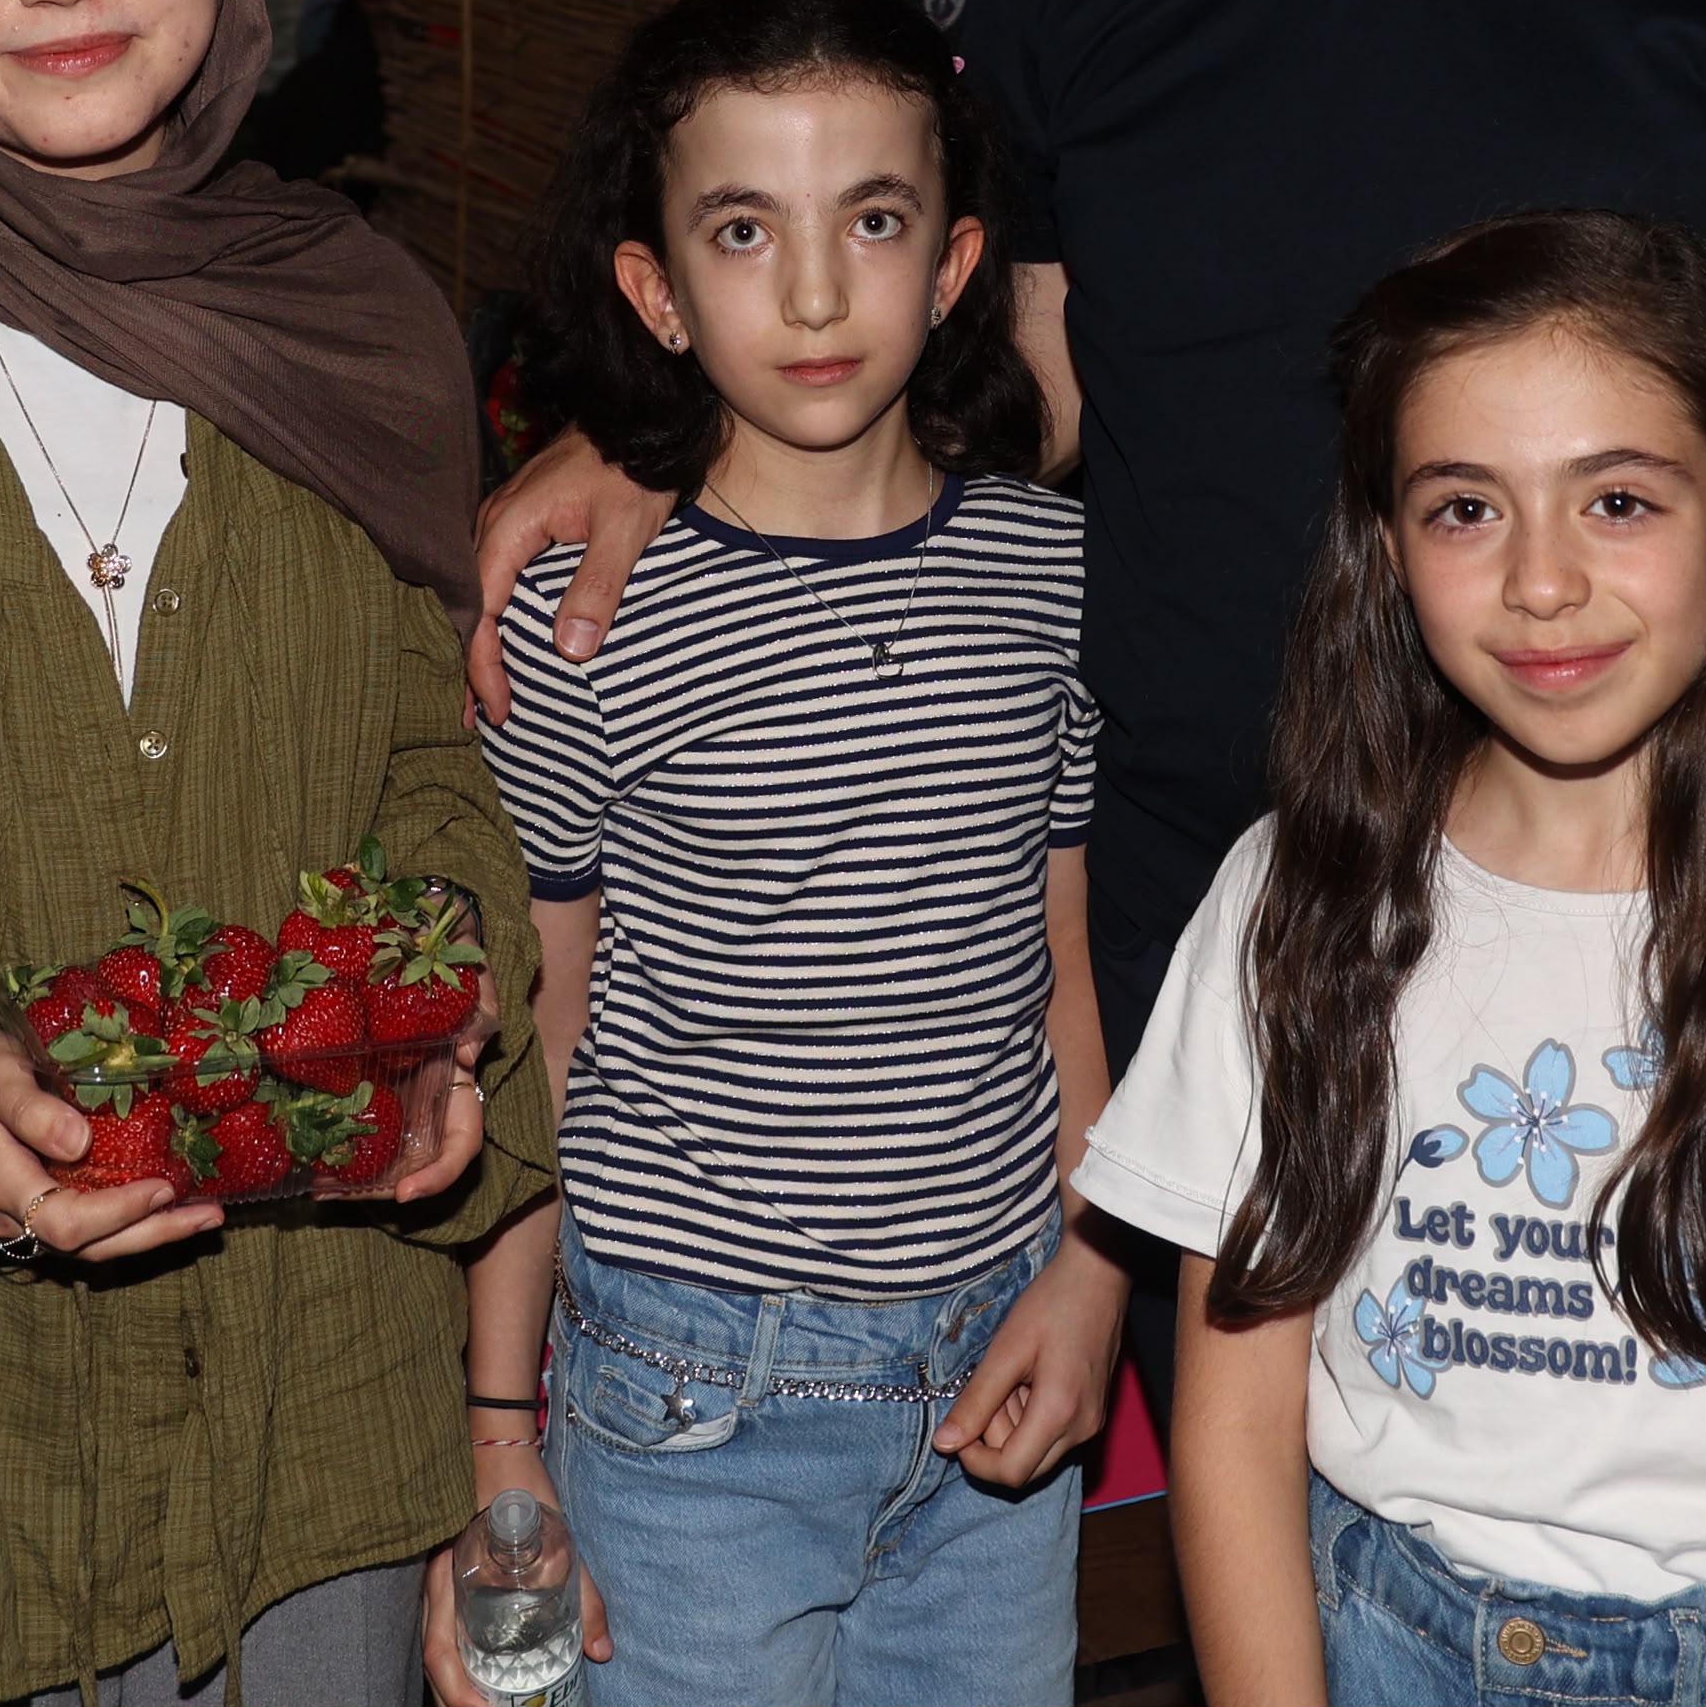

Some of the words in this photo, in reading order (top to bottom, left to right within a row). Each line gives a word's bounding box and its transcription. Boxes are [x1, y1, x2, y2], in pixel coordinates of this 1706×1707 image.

[1396, 1197, 1476, 1247] Let
[1493, 1213, 1616, 1261] your
[1406, 1256, 1594, 1320] dreams
[1421, 1317, 1638, 1384] blossom!
